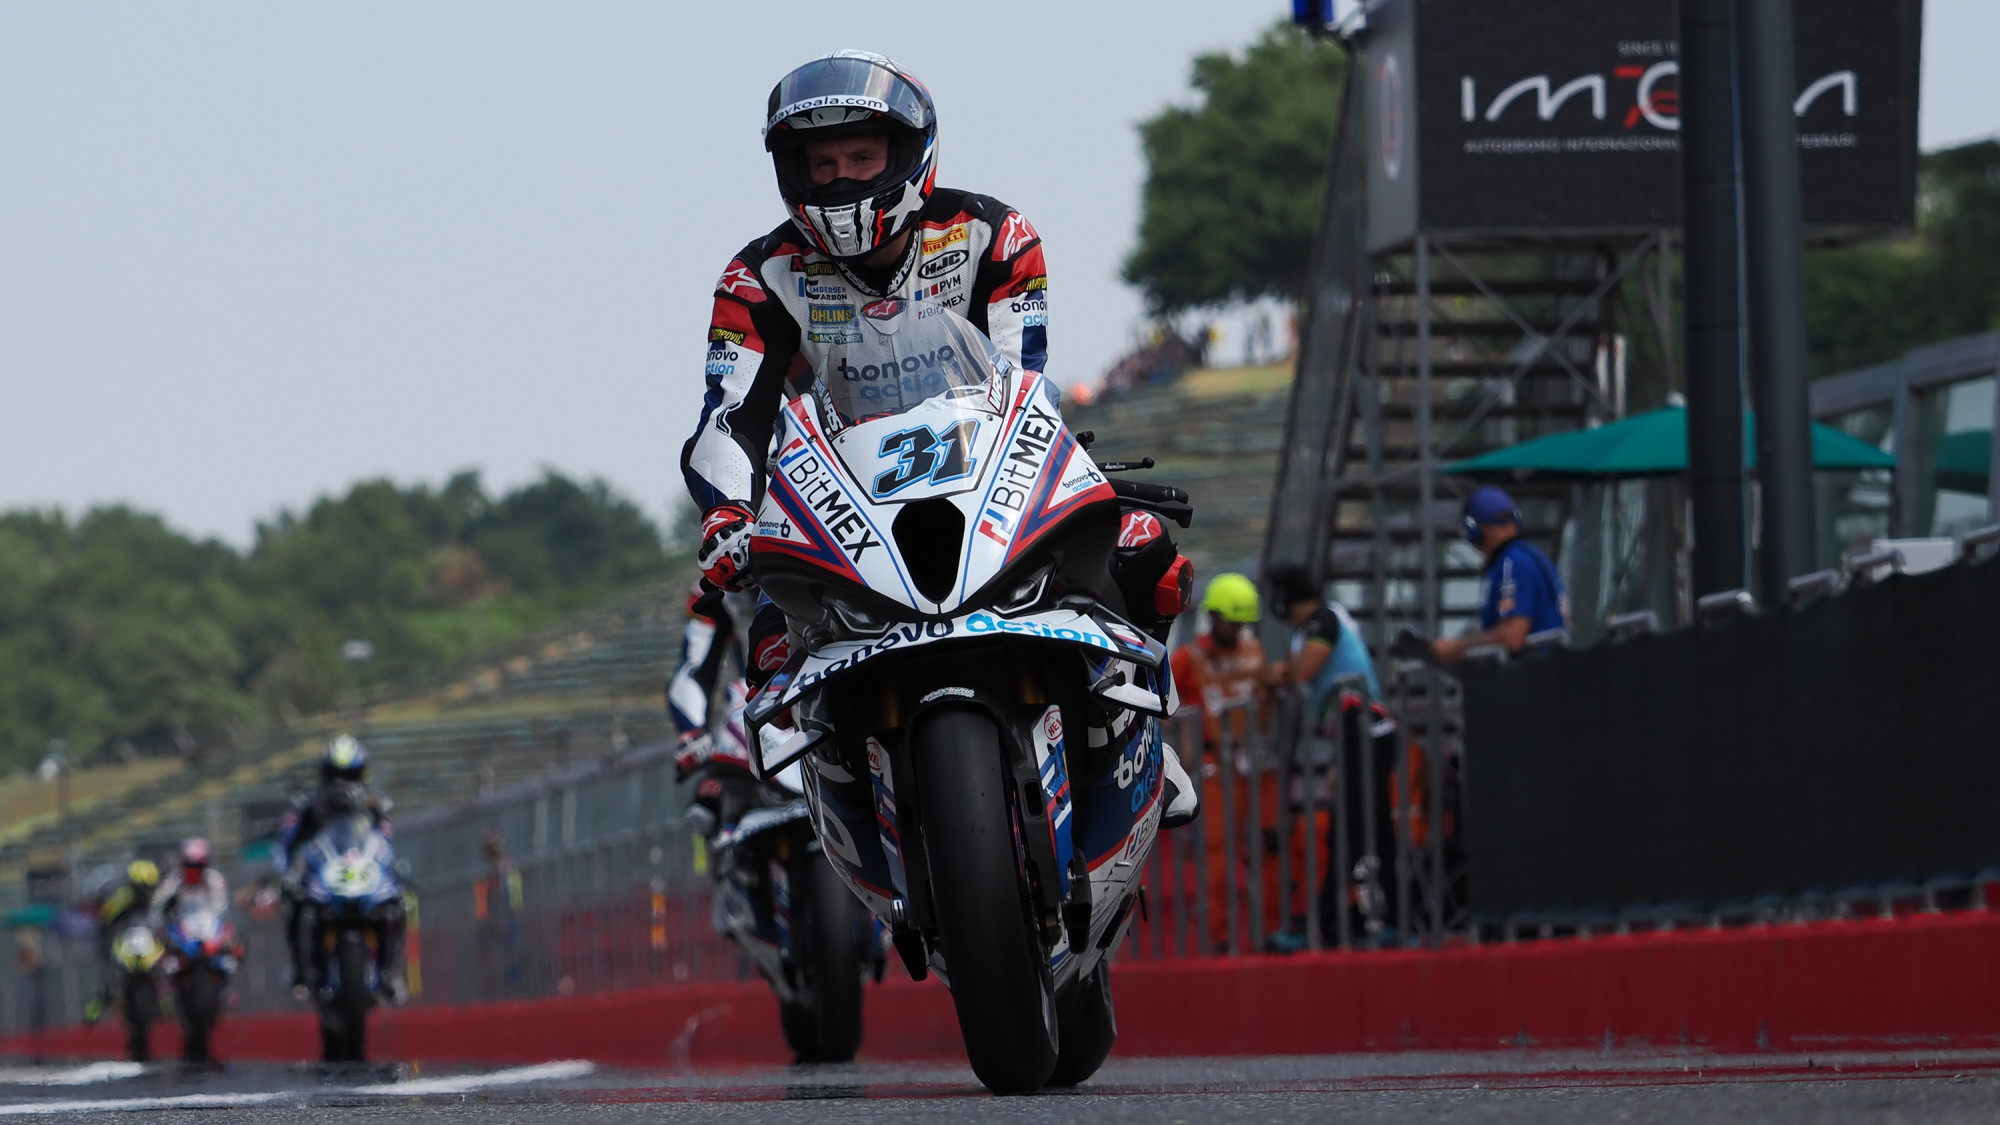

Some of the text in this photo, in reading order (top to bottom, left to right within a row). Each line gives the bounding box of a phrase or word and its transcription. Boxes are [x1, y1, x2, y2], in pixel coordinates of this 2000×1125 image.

[925, 252, 961, 276] HJC
[940, 275, 962, 292] PVM
[706, 350, 739, 361] novo
[837, 345, 955, 382] bonovo
[706, 362, 736, 375] ction
[860, 371, 944, 400] actio
[871, 418, 982, 498] 31
[991, 404, 1062, 512] BitMEX
[1062, 473, 1088, 488] bonovo
[1072, 480, 1092, 493] action
[788, 456, 881, 564] BitMEX
[759, 520, 779, 529] bonovo
[759, 527, 778, 536] action
[966, 613, 1108, 649] action
